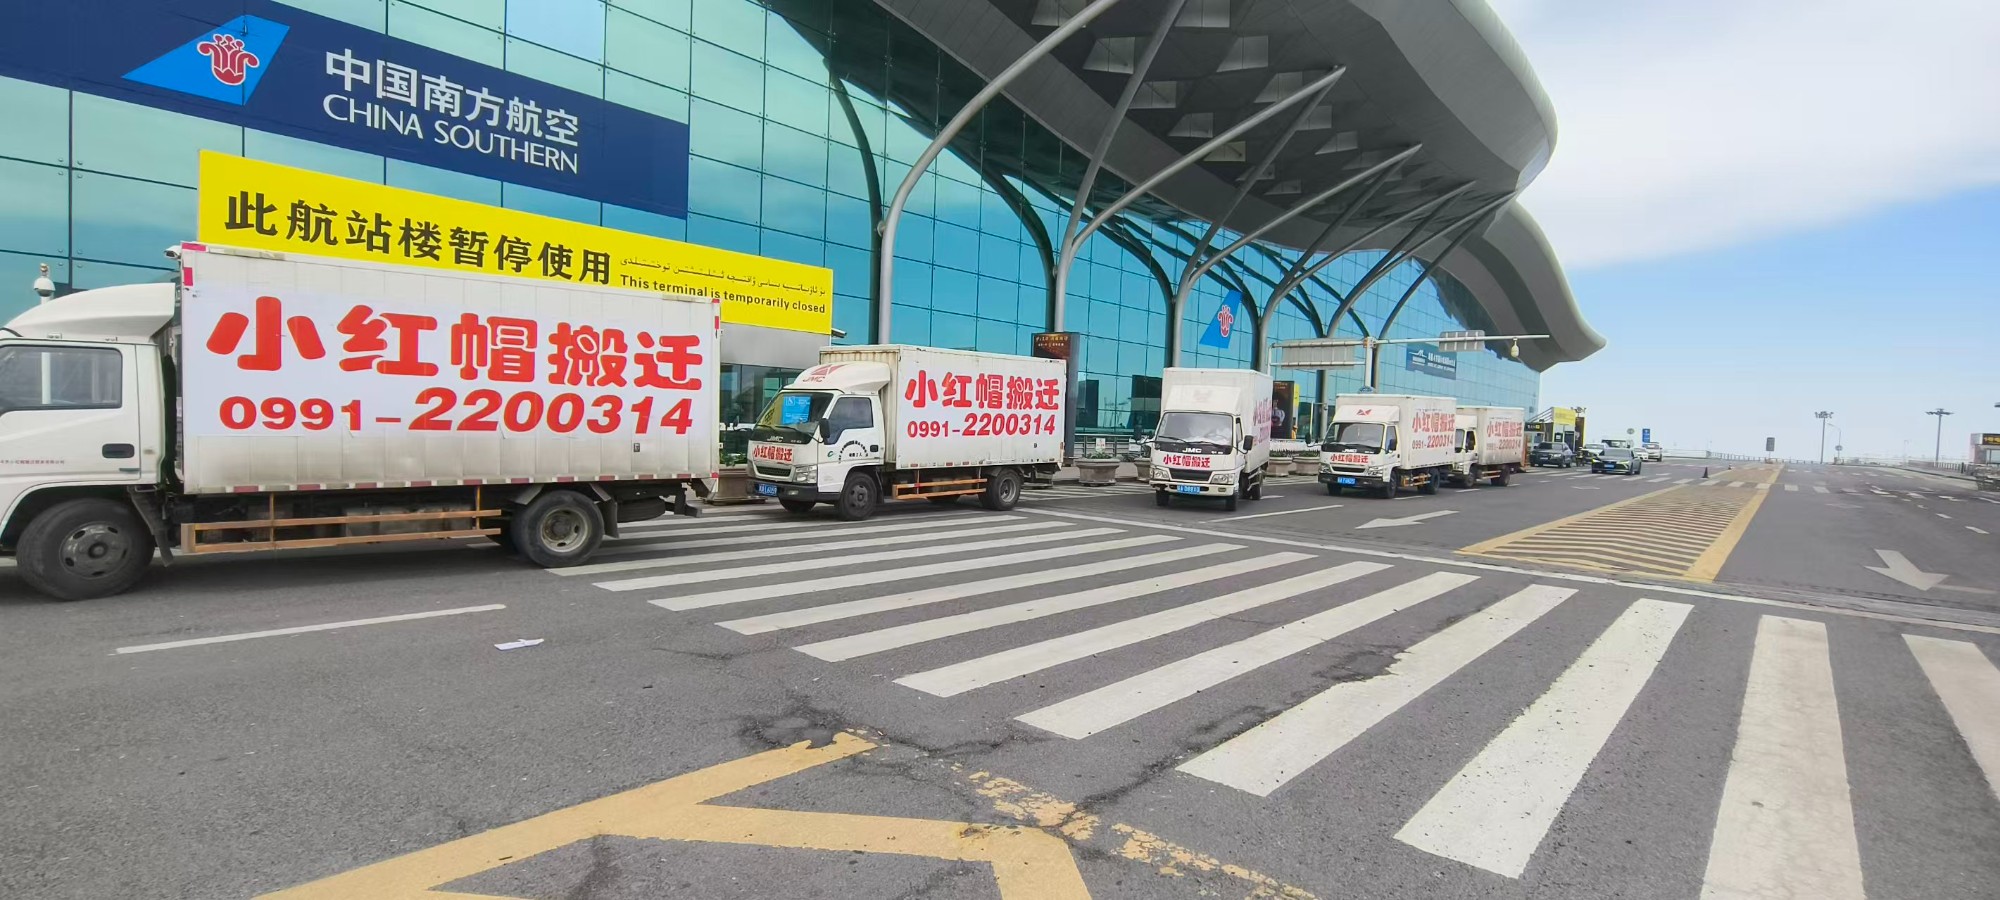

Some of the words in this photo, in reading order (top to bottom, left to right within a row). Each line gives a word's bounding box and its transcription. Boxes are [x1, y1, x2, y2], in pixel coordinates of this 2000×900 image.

[326, 48, 579, 148] 中国南方航空
[322, 93, 424, 141] CHINA
[434, 120, 579, 174] SOUTHERN
[225, 190, 610, 285] 此航站楼暂停使用
[620, 274, 650, 290] This
[653, 280, 708, 298] terminal
[710, 286, 721, 299] is
[724, 289, 790, 311] temporarily
[792, 301, 826, 314] closed
[206, 295, 703, 390] 小红帽搬迁
[219, 386, 693, 435] 0991-2200314
[905, 369, 1059, 411] 小红帽搬迁
[907, 412, 1056, 438] 0991-2200314
[1412, 411, 1455, 433] 小红帽搬迁
[753, 444, 793, 462] 小红帽搬迁
[1163, 454, 1211, 468] 小红帽搬迁
